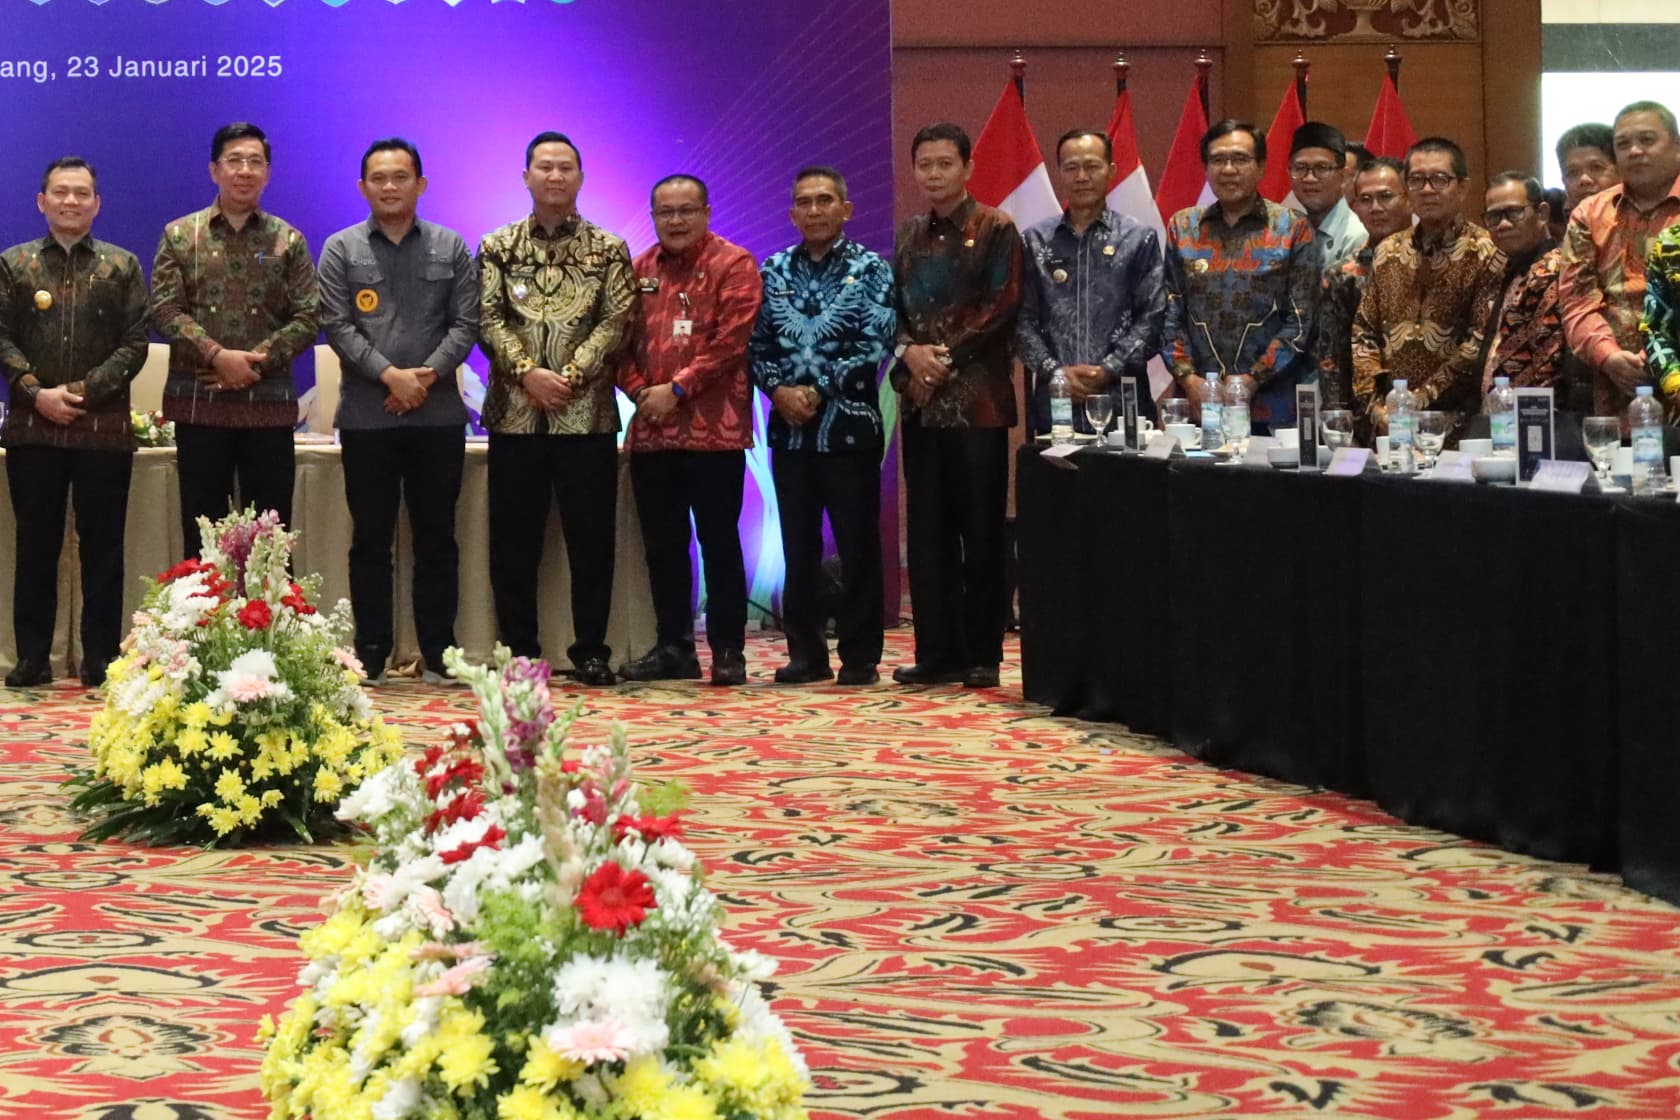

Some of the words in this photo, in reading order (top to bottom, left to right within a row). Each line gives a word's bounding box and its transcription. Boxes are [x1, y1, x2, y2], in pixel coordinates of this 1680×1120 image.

[67, 55, 99, 78] 23
[108, 55, 207, 78] Januari
[217, 55, 283, 77] 2025
